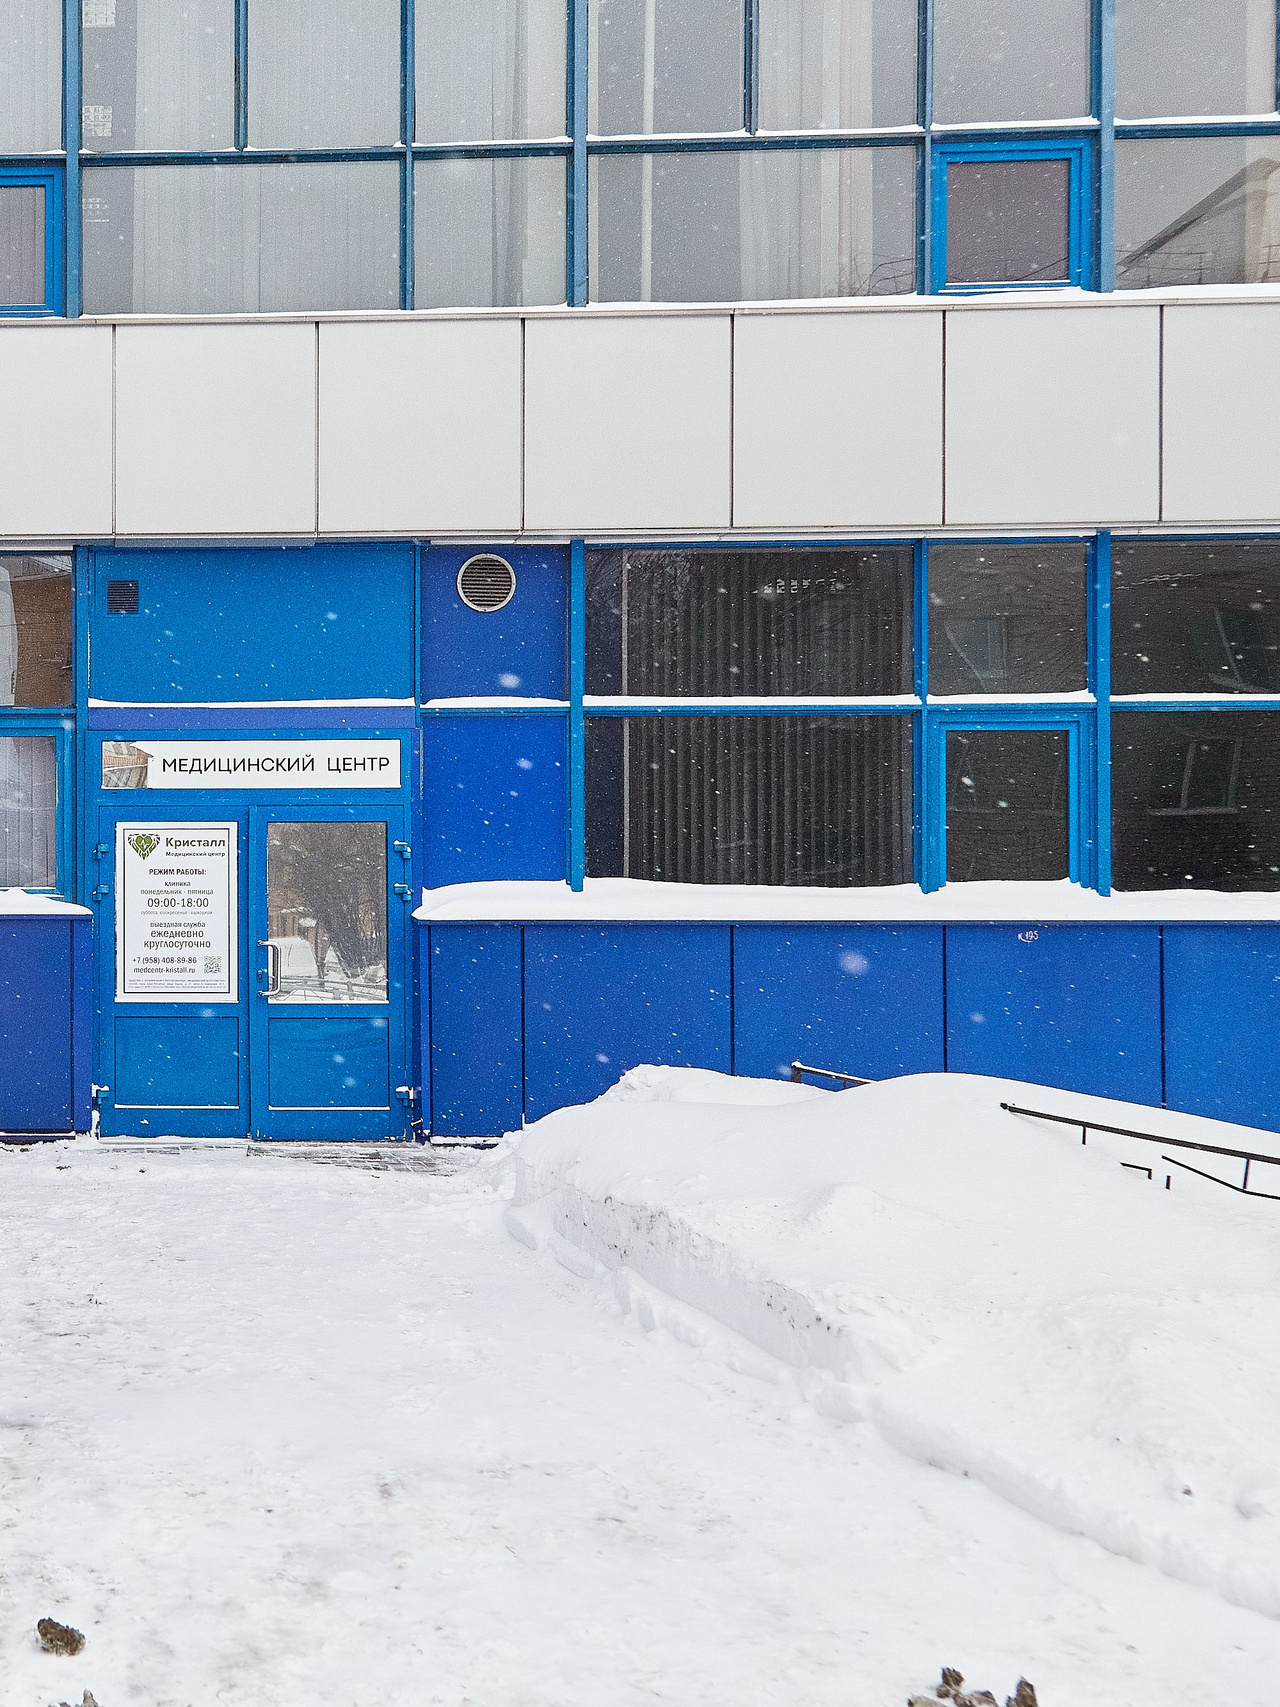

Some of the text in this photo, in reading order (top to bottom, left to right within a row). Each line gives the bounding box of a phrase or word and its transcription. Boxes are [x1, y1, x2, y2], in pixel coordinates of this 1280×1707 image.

[162, 754, 390, 775] МЕДИЦИНСКИЙ ЦЕНТР
[165, 837, 226, 849] Кристалл
[147, 897, 209, 908] 09:00-18:00
[149, 921, 206, 929] выездная служба
[150, 930, 204, 939] ежедневно
[143, 940, 211, 950] круглосуточно
[132, 956, 197, 965] +7 (958) 408-89-86
[133, 966, 196, 974] medcentr-kristall.ru
